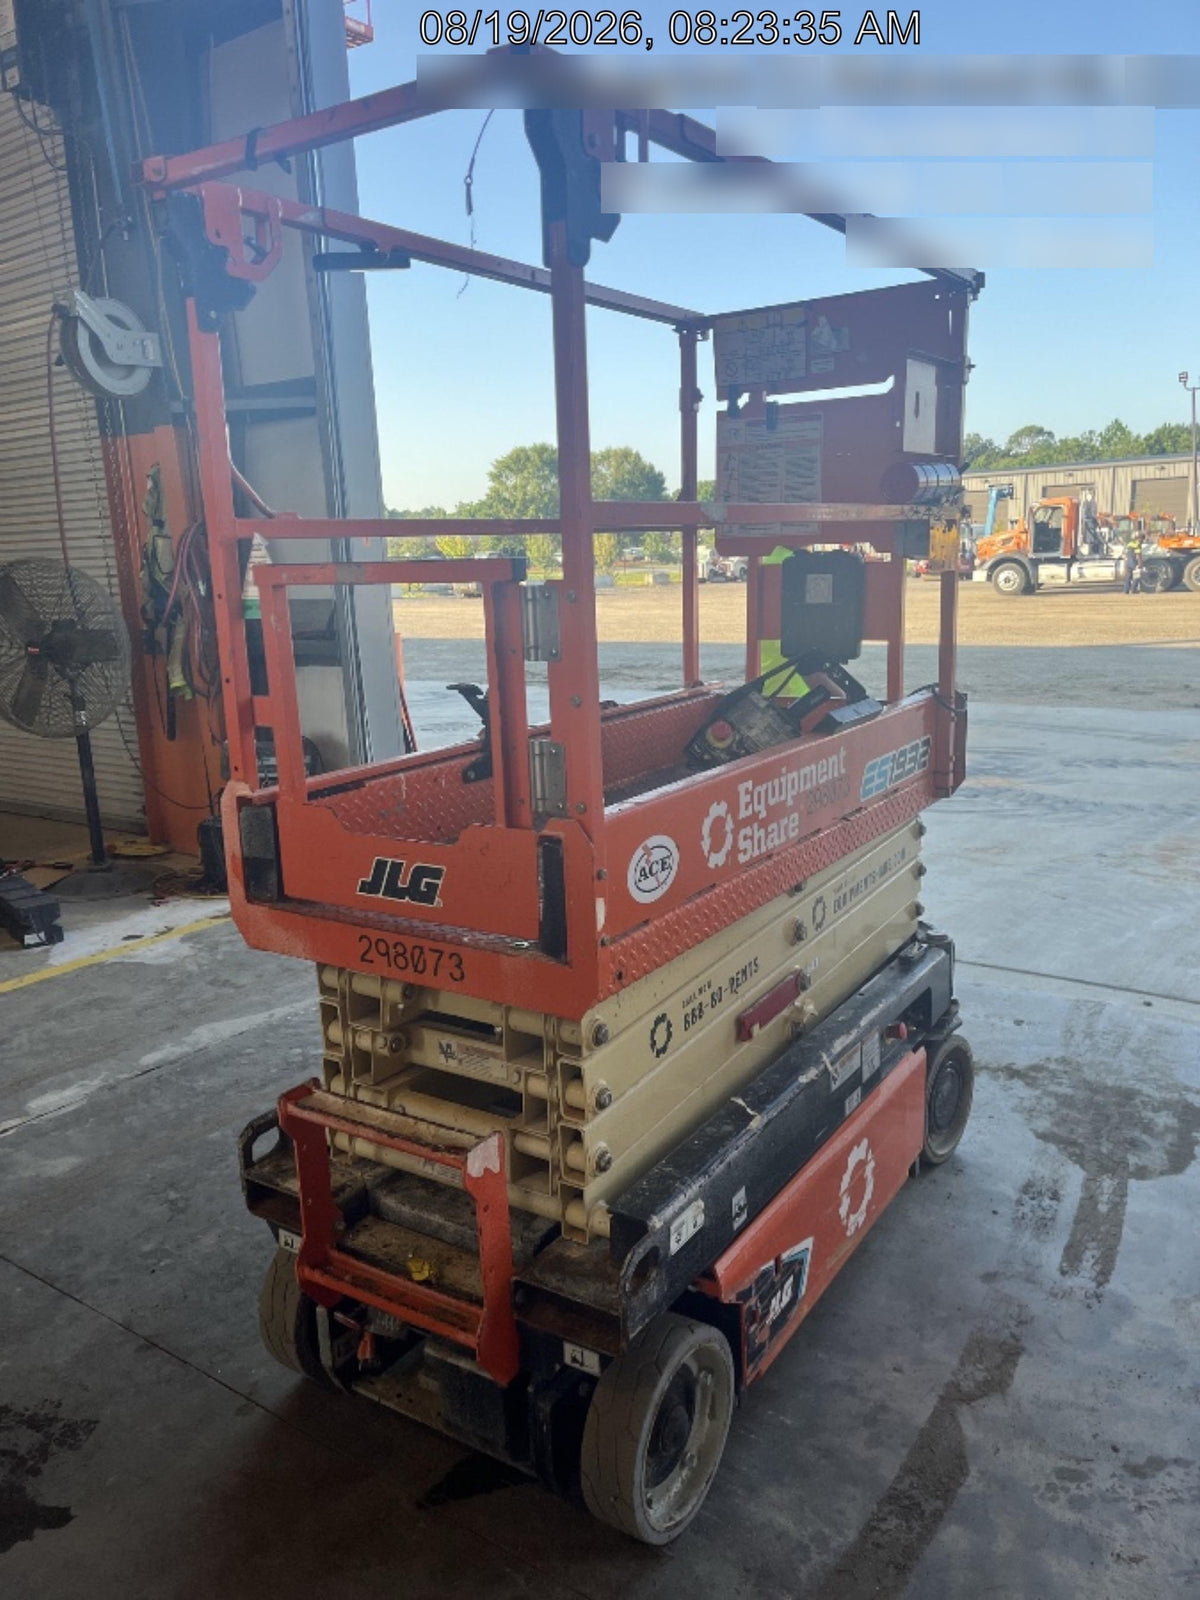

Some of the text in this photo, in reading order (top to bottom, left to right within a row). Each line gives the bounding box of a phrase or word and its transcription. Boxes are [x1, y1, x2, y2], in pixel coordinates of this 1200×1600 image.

[738, 747, 846, 819] Equipment
[738, 813, 799, 864] Share
[356, 857, 445, 907] JLG
[638, 855, 672, 882] ACE
[358, 935, 465, 982] 298073
